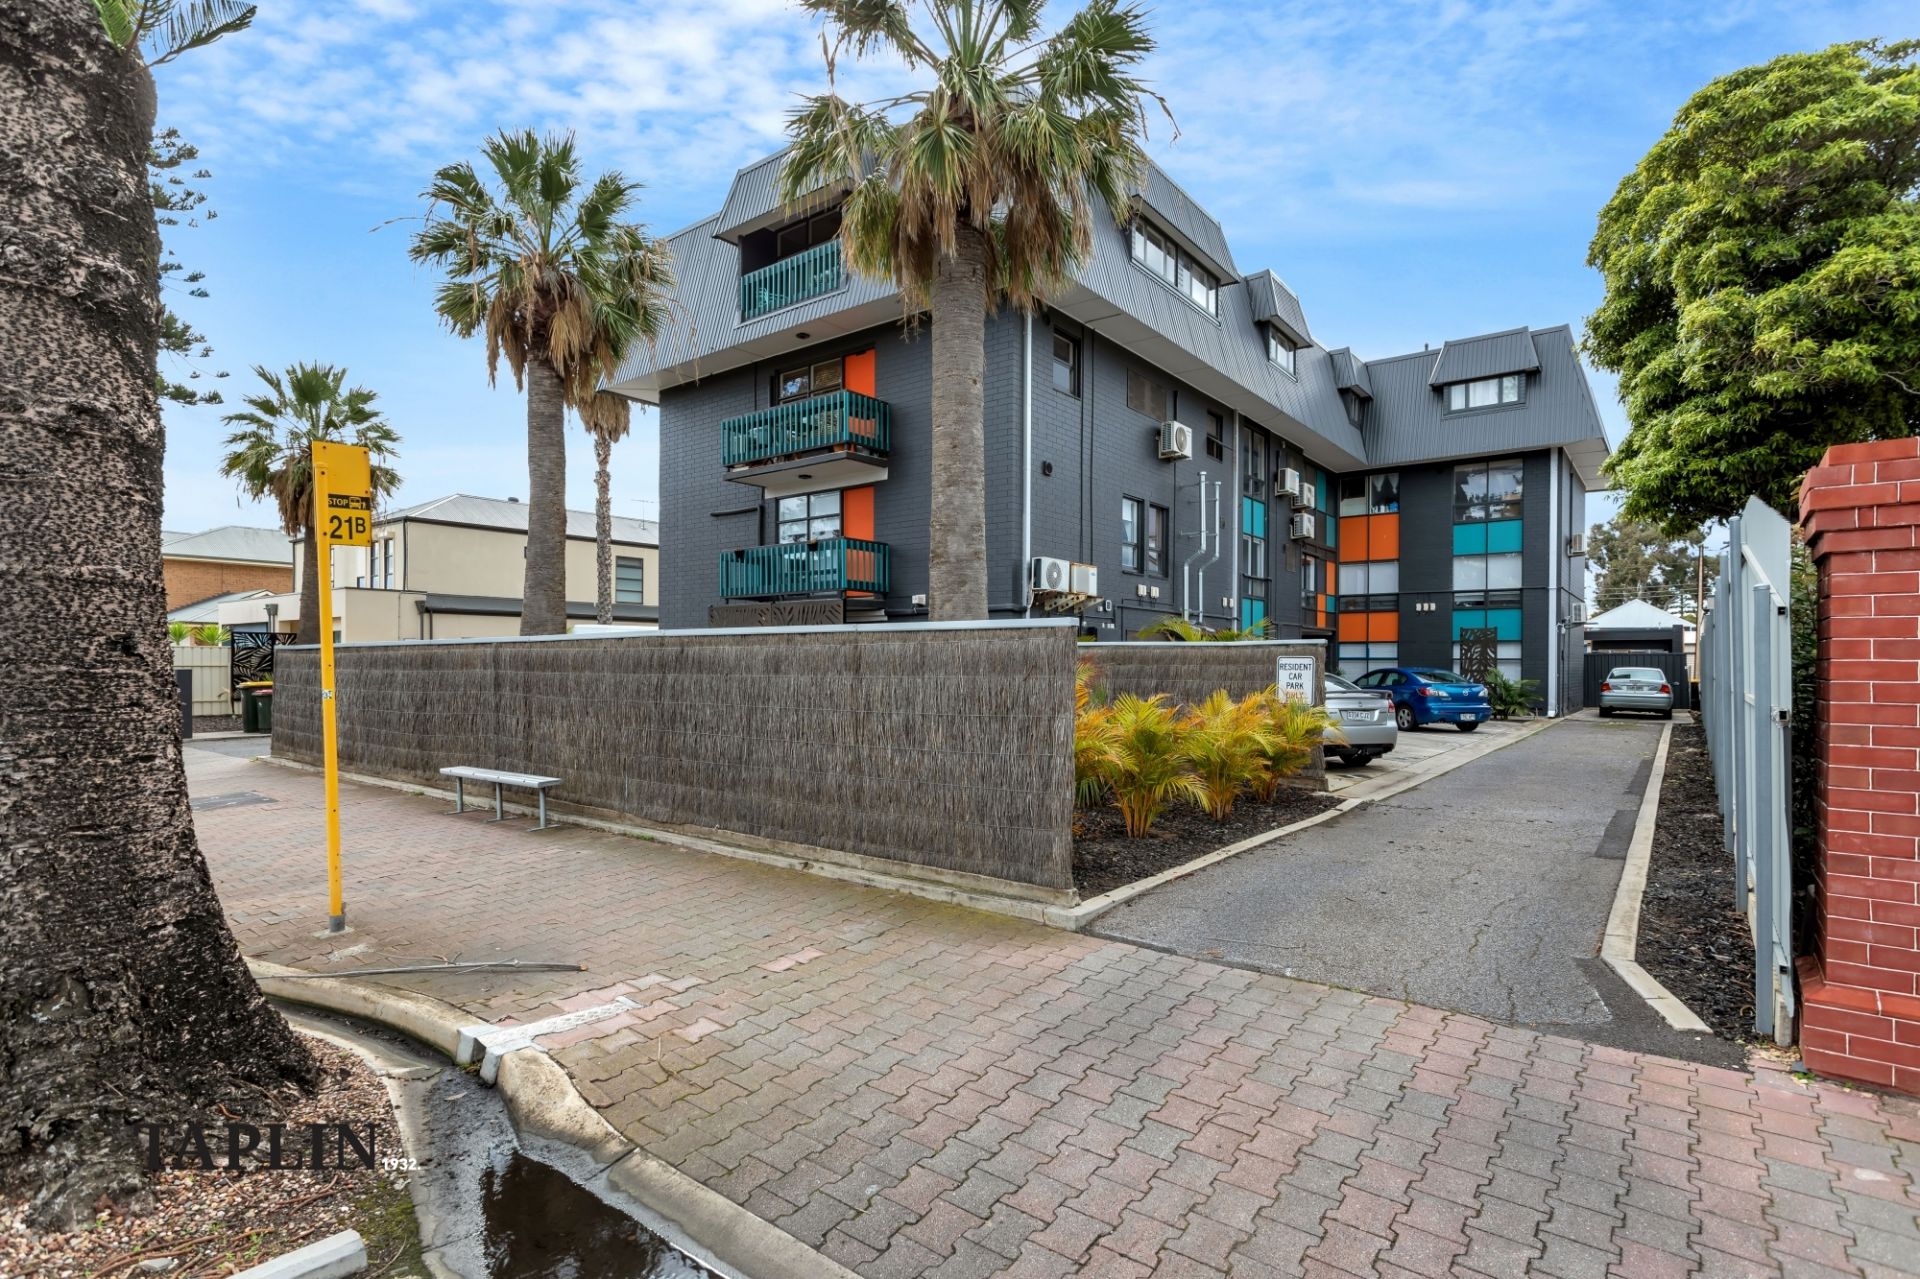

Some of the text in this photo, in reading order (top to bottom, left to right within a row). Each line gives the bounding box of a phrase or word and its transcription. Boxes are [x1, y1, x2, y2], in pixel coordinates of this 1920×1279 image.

[328, 498, 348, 506] STOP
[329, 514, 366, 540] 21B
[1279, 663, 1312, 671] RESIDENT
[1288, 672, 1303, 680] CAR
[1286, 681, 1304, 690] PARK
